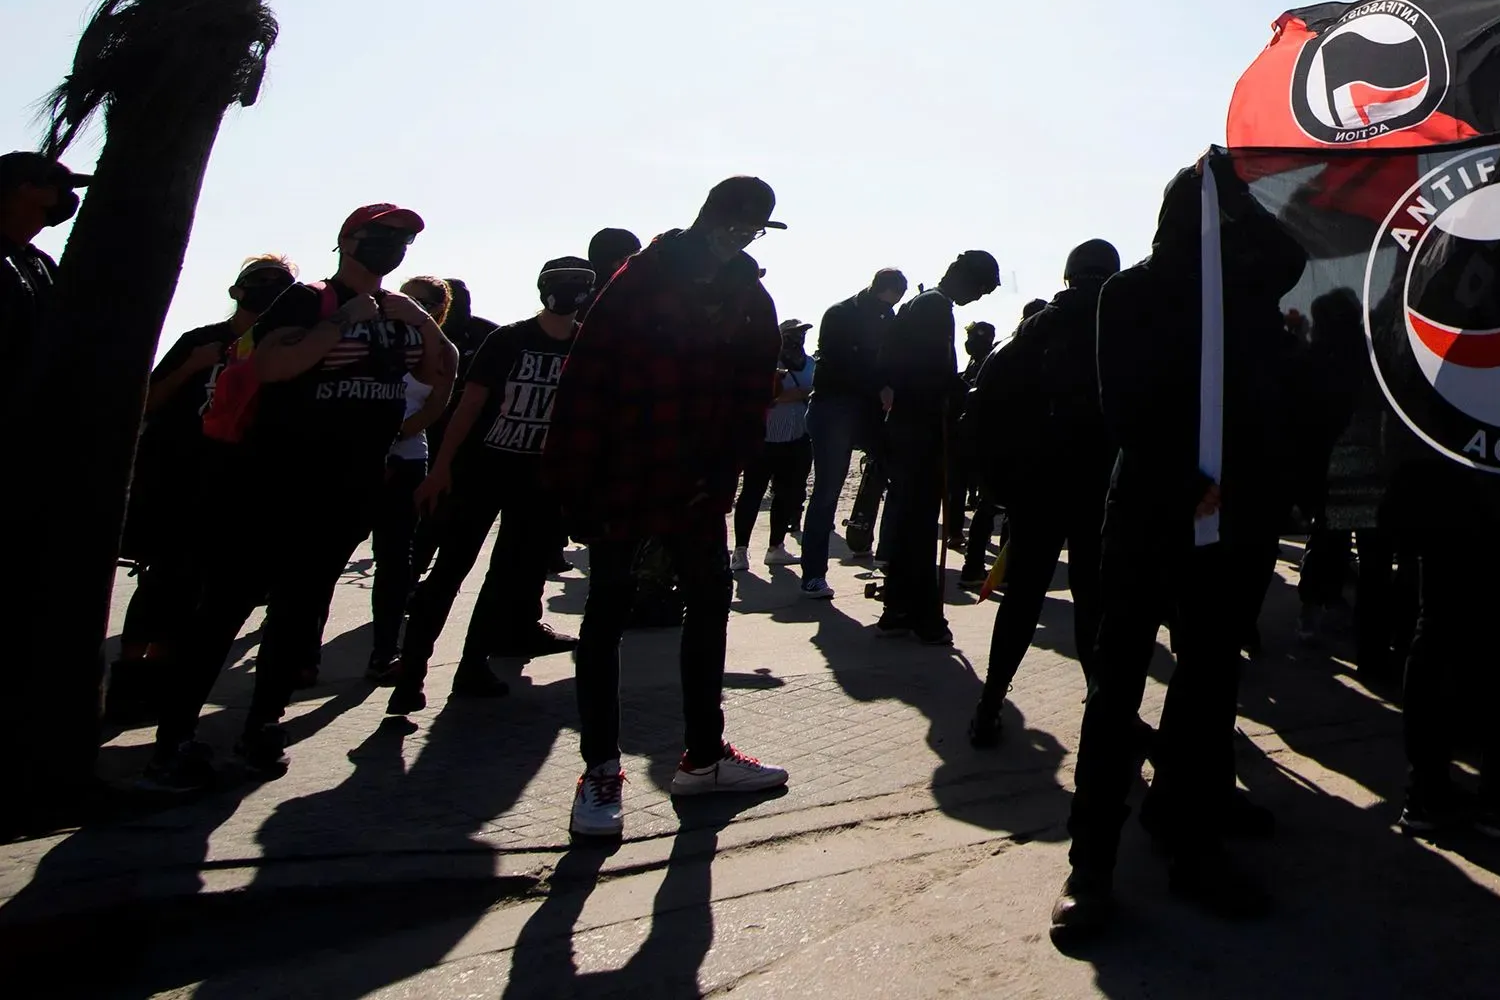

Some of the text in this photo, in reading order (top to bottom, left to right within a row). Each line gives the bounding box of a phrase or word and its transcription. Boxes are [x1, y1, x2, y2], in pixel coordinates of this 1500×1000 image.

[516, 352, 562, 384] BLA
[315, 382, 335, 400] IS
[507, 384, 555, 417] LIV
[487, 418, 551, 450] MATT
